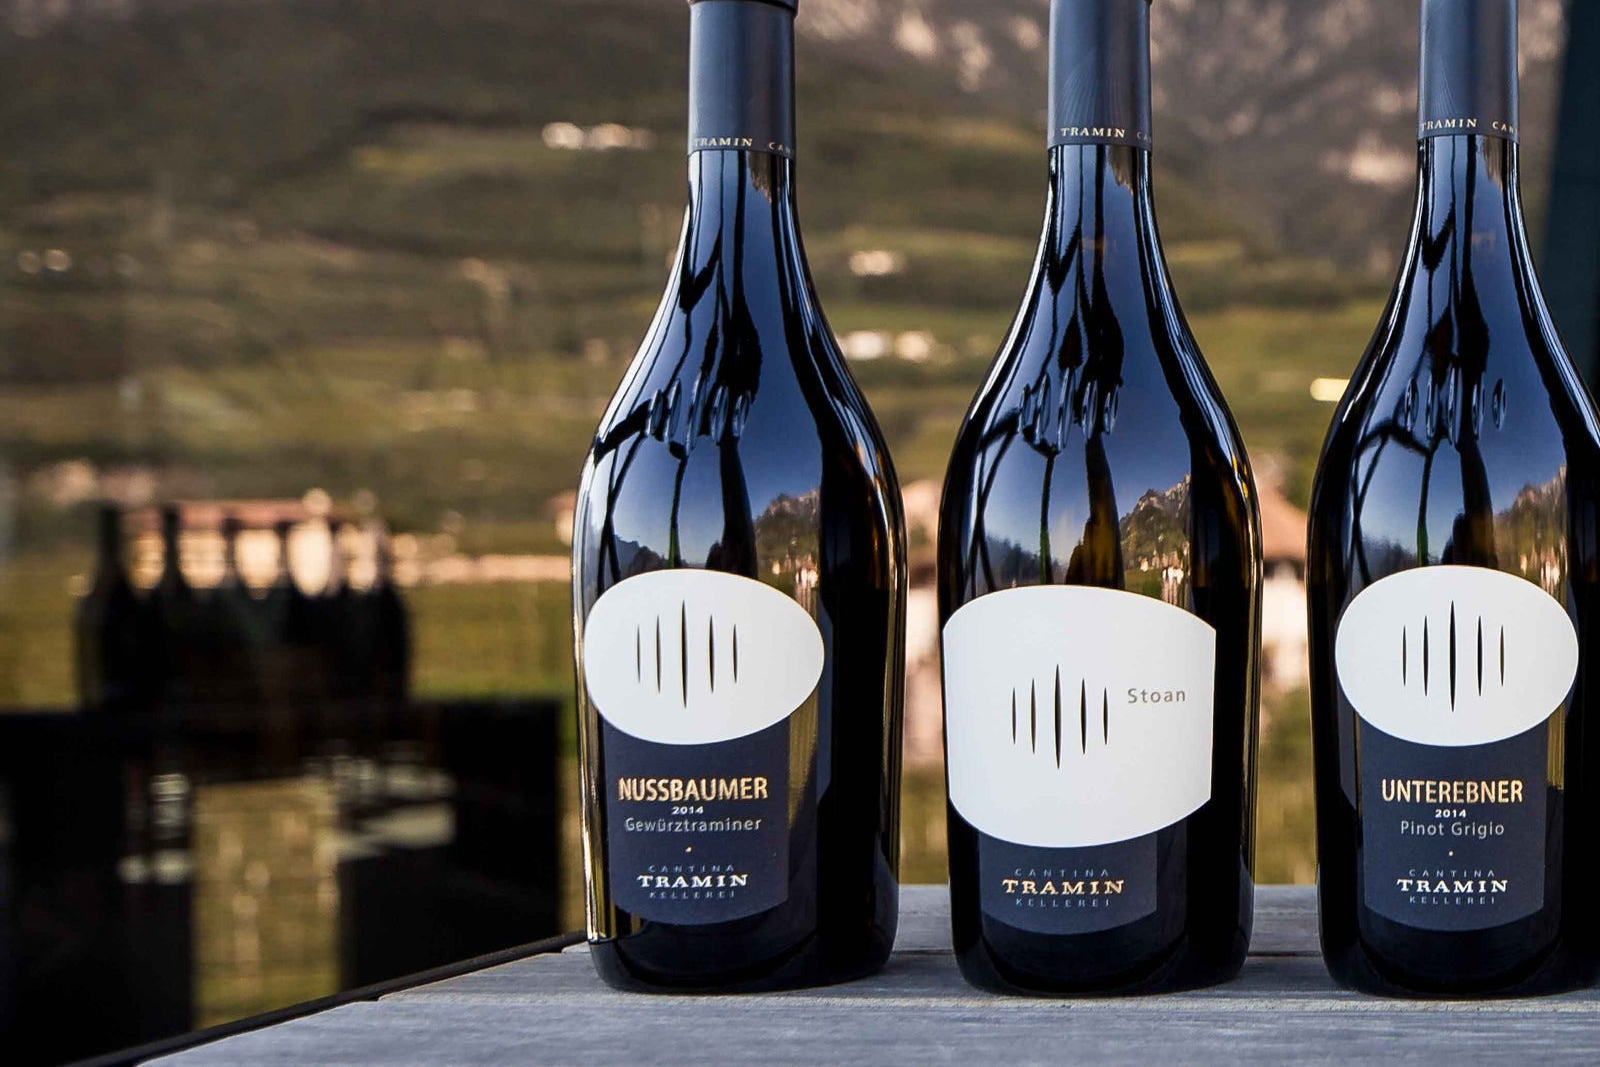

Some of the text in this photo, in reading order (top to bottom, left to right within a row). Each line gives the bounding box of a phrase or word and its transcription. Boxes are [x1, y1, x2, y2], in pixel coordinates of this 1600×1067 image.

[1420, 118, 1477, 131] TRAMIN
[1061, 127, 1125, 138] TRAMIN
[694, 137, 752, 147] TRAMIN
[1127, 688, 1186, 704] Stoan
[618, 776, 769, 802] NUSSBAUMER
[1381, 778, 1524, 804] UNTEREBNER
[671, 805, 705, 815] 2014
[1434, 808, 1467, 819] 2014
[624, 816, 762, 833] Gewürztraminer
[1400, 820, 1505, 840] Pinot Grigio
[647, 864, 735, 874] CANTINA
[1014, 868, 1110, 878] CANTINA
[1409, 868, 1496, 878] CANTINA
[636, 873, 749, 889] TRAMIN
[1001, 878, 1126, 895] TRAMIN
[1396, 878, 1509, 893] TRAMIN
[1015, 898, 1110, 908] KELLEREI
[1409, 895, 1496, 905] KELLEREI
